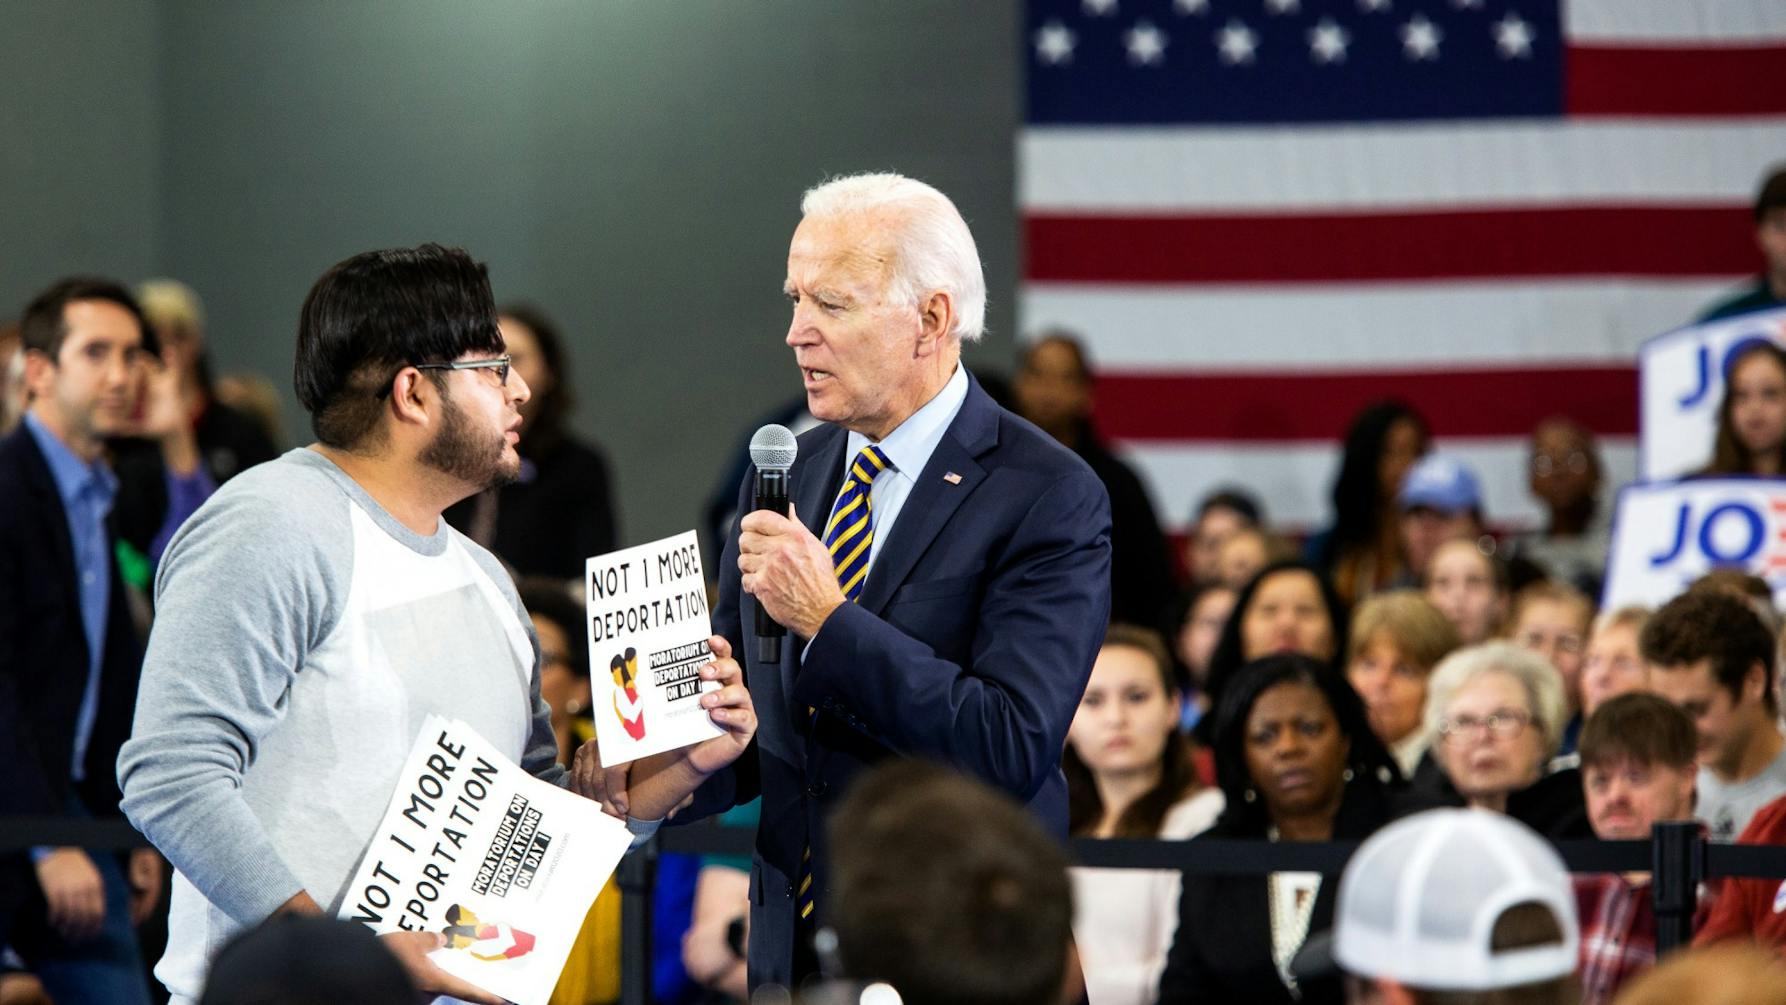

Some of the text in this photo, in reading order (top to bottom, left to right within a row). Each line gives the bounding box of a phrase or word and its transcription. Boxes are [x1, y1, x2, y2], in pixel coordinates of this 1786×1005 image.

[1650, 501, 1786, 569] JO
[592, 562, 630, 602] NOT
[658, 544, 699, 584] MORE
[593, 587, 706, 643] DEPORTATION
[649, 642, 700, 667] MORATORIUM
[667, 686, 679, 700] ON
[680, 681, 696, 697] DAY
[352, 860, 401, 935] NOT
[402, 730, 466, 830] MORE
[398, 756, 498, 932] EPORTATION
[472, 794, 527, 894] MORATORIUM ON
[492, 808, 541, 897] DEPORTATIONS
[516, 869, 534, 887] ON
[525, 842, 544, 868] DAY
